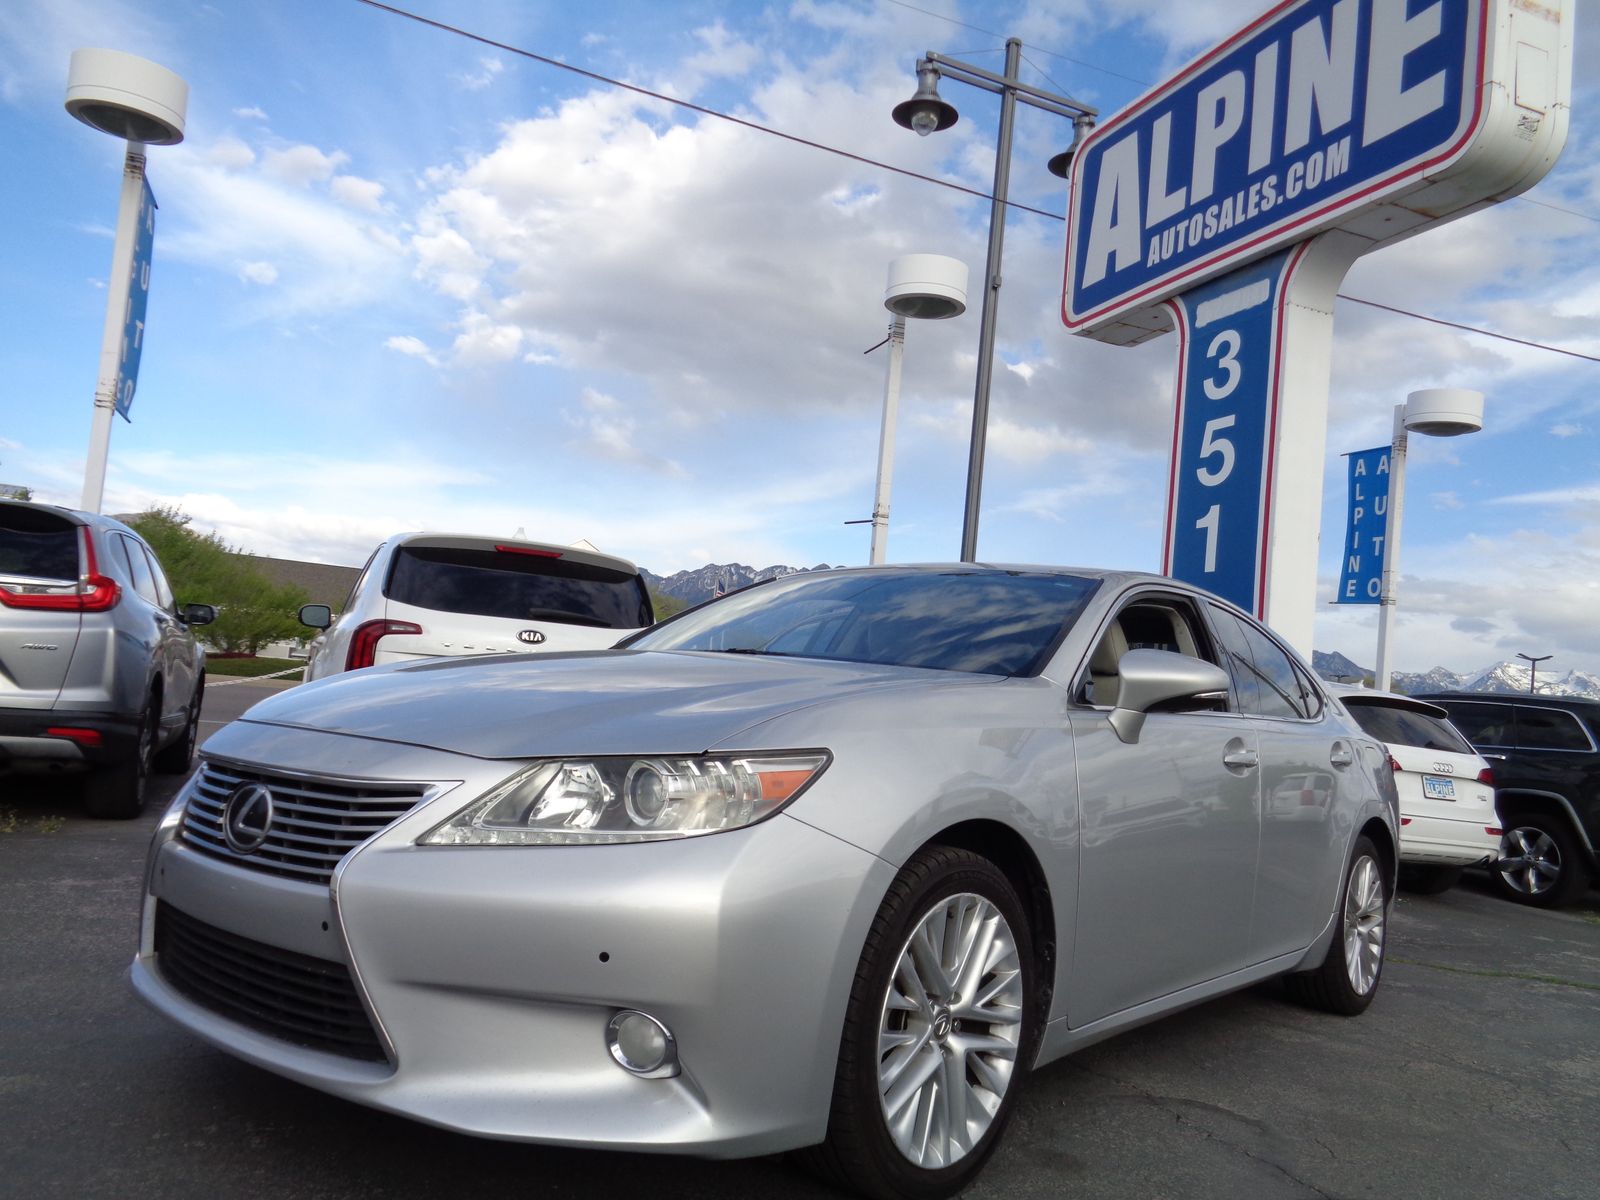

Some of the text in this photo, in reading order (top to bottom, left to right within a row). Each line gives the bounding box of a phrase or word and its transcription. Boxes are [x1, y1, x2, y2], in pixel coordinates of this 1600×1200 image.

[1082, 0, 1446, 289] ALPINE
[1147, 135, 1351, 268] AUTOSALES.COM
[1346, 458, 1367, 598] ALPINE
[1367, 454, 1390, 598] AUTO
[521, 631, 542, 642] KIA
[1425, 782, 1455, 797] ALPINE
